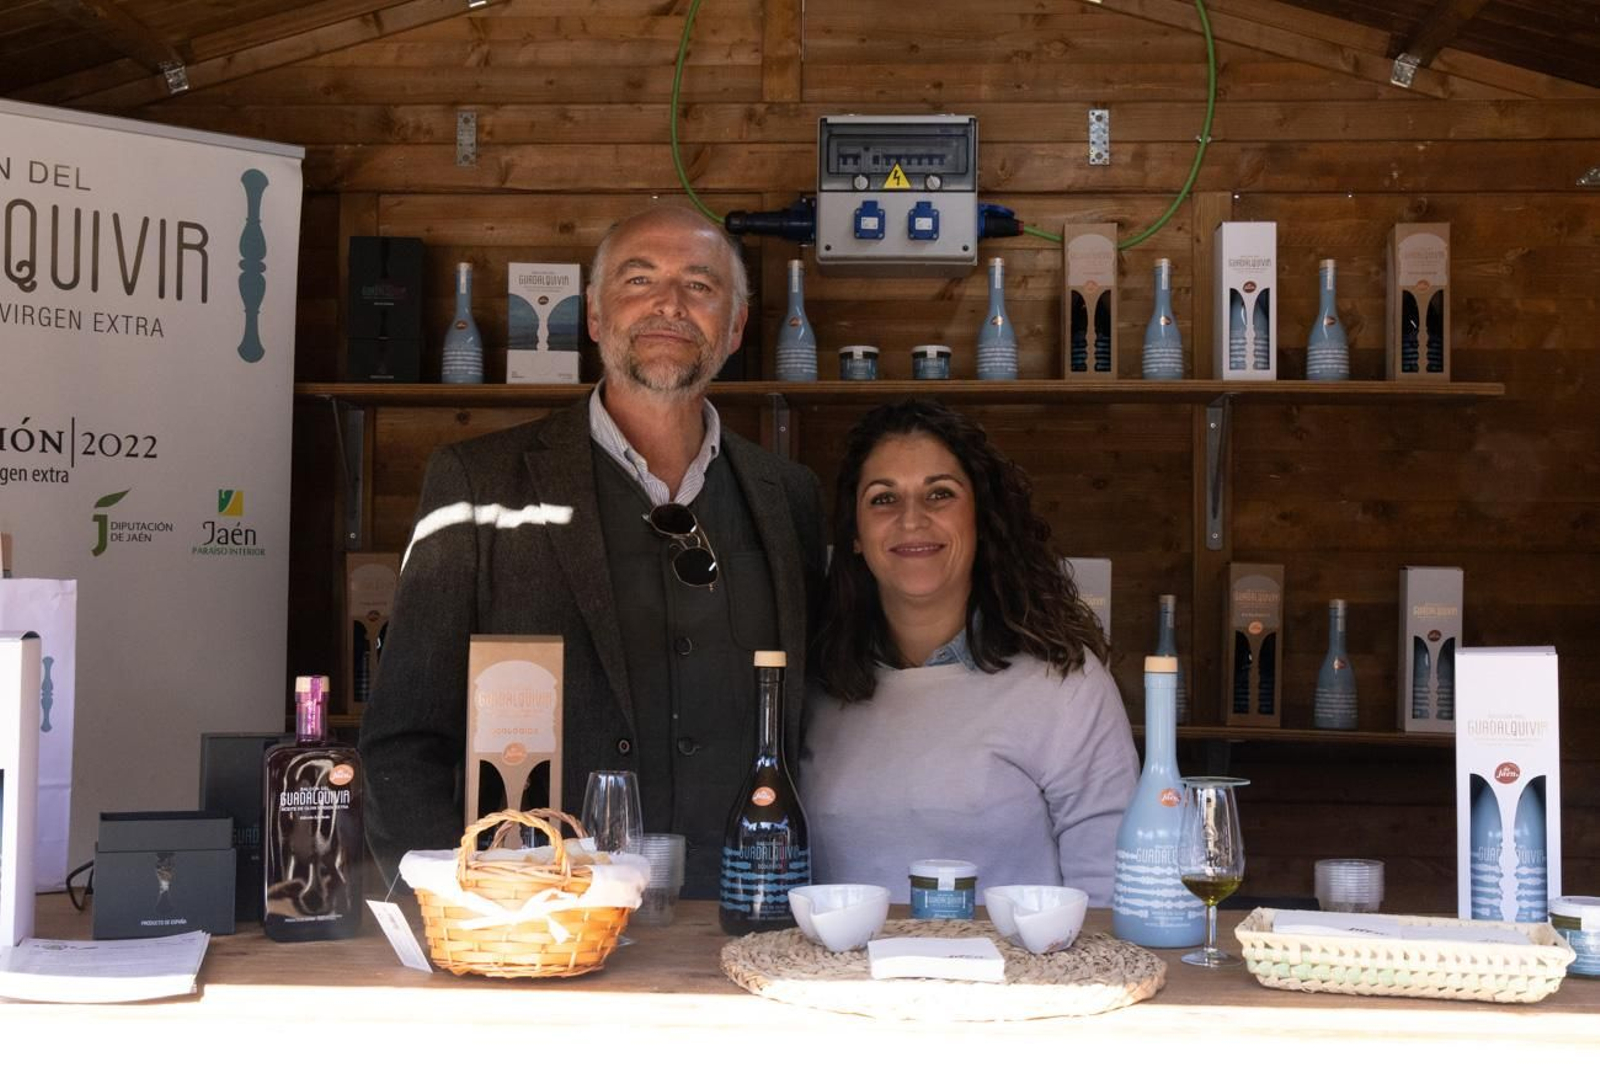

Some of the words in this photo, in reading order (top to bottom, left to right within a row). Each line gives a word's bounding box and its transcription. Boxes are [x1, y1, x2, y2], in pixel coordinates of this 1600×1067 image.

[29, 160, 92, 192] DEL
[5, 198, 209, 304] QUIVIR
[0, 303, 82, 331] VIRGEN
[93, 312, 165, 338] EXTRA
[81, 431, 158, 459] 2022
[32, 467, 70, 484] extra
[110, 521, 174, 532] DIPUTACIÓN
[110, 532, 124, 542] DE
[126, 532, 153, 543] JAÉN
[202, 521, 257, 546] Jaén
[279, 789, 351, 807] GUADALQUIVIR
